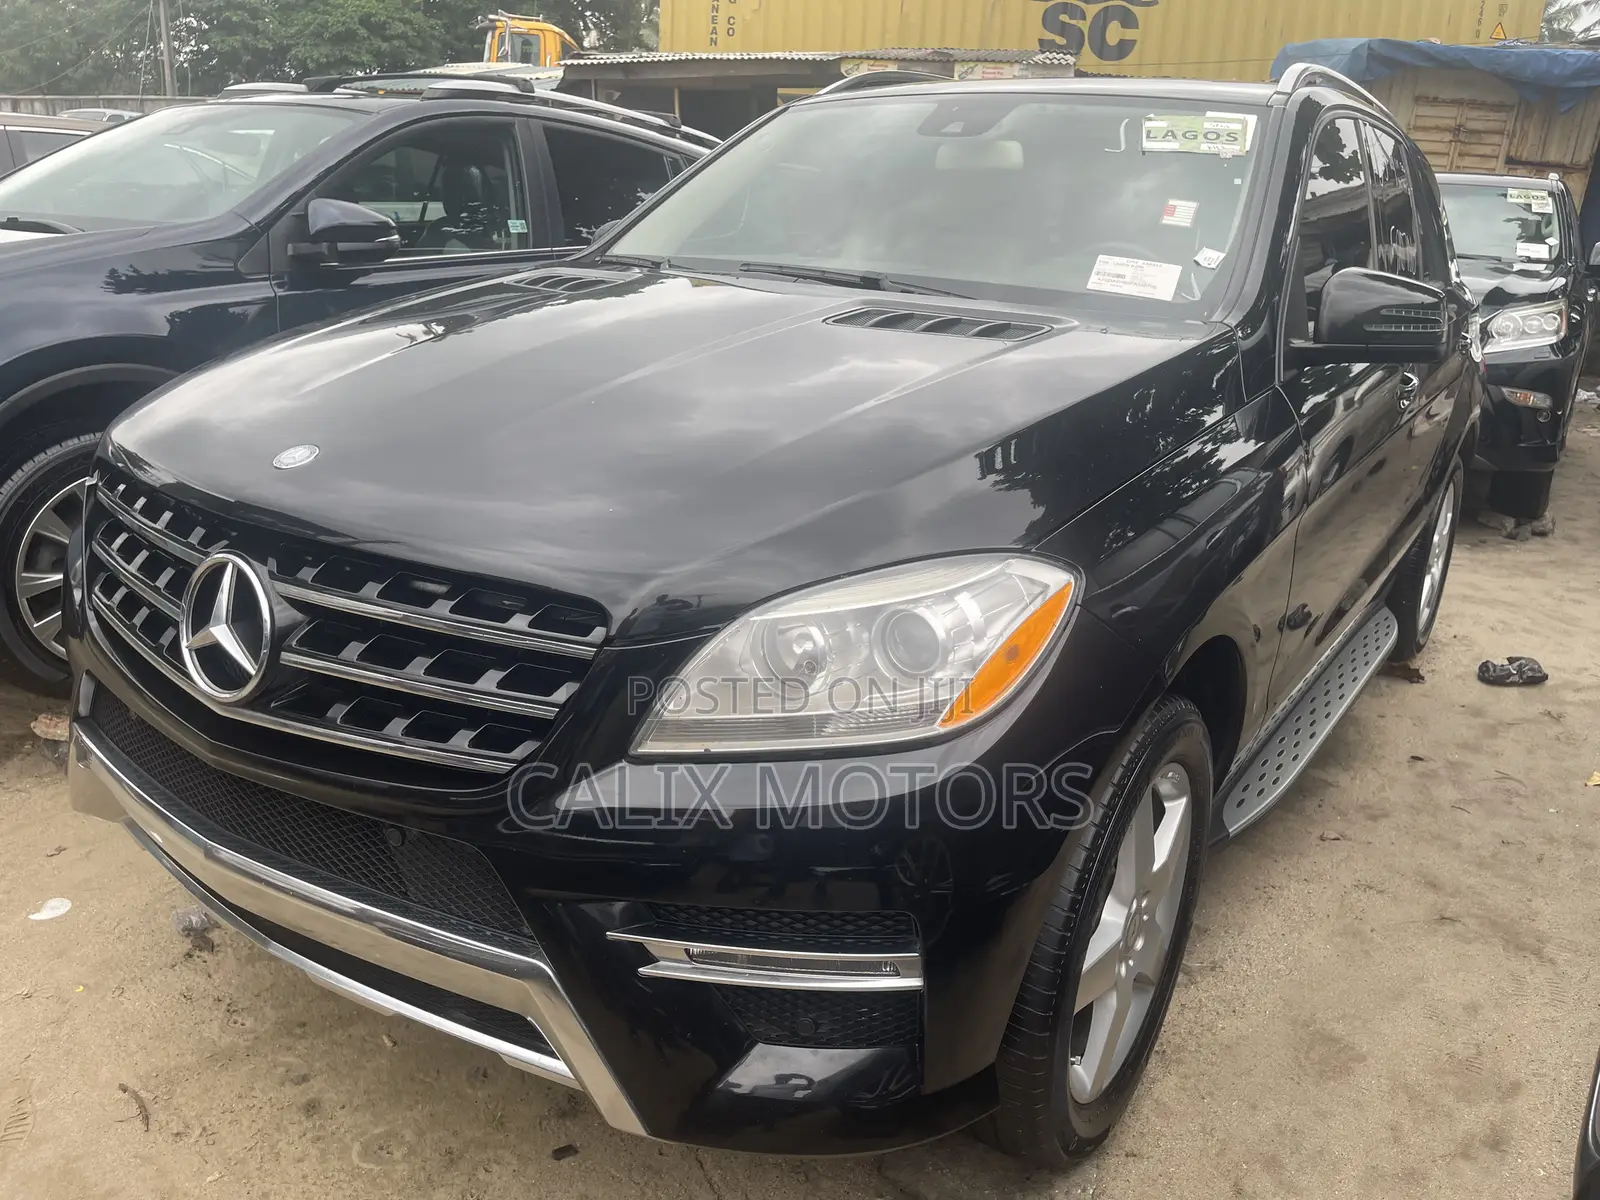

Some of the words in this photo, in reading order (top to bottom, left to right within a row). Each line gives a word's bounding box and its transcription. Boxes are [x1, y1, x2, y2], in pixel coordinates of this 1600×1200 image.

[709, 0, 720, 47] NEAN
[727, 15, 736, 37] CO
[1145, 129, 1240, 143] LAGOS
[1509, 193, 1547, 201] LAGOS
